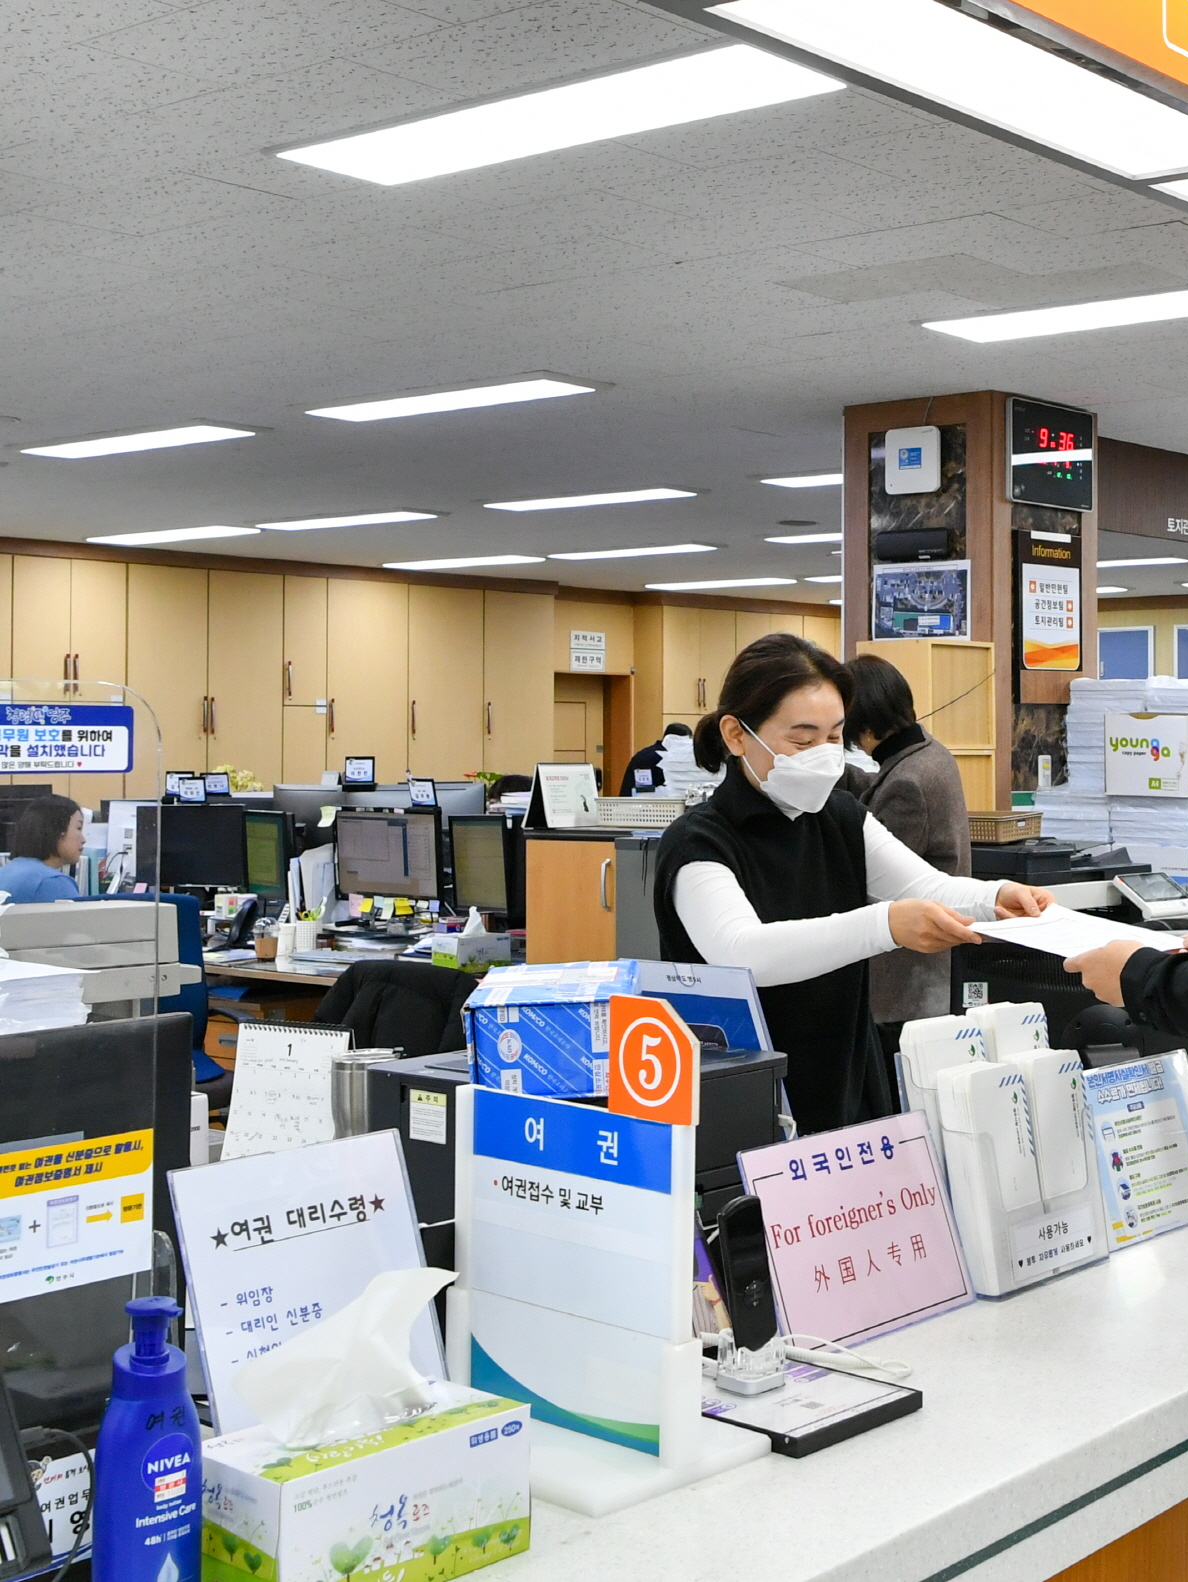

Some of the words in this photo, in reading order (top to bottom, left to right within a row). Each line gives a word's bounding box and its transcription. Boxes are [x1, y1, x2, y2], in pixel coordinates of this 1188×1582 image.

[1031, 544, 1071, 560] Information
[1039, 582, 1068, 595] 일반민원팀
[1034, 599, 1064, 611] 공간정보팀
[1034, 615, 1064, 628] 토지관리팀
[0, 728, 30, 742] 무원
[34, 728, 73, 742] 보호를
[77, 729, 113, 742] 위하여
[27, 744, 106, 758] 설치했습니다
[286, 1043, 293, 1057] 1
[1086, 1063, 1150, 1089] 본인서명사실확인서
[33, 1152, 63, 1169] 여권을
[65, 1144, 113, 1164] 신분증으로
[788, 1135, 895, 1182] 외국인전용
[14, 1167, 82, 1188] 여권정보증명서
[85, 1161, 104, 1173] 제시
[501, 1174, 555, 1206] 여권접수
[558, 1187, 572, 1211] 및
[575, 1192, 604, 1216] 교부
[230, 1215, 275, 1245] 여권
[286, 1194, 367, 1229] 대리수령
[769, 1223, 802, 1250] For
[807, 1190, 897, 1239] foreigner's
[900, 1182, 937, 1211] Only
[1038, 1220, 1069, 1241] 사용가능
[813, 1233, 928, 1294] 外国人专用
[236, 1286, 274, 1307] 위임장
[240, 1313, 279, 1333] 대리인
[286, 1302, 323, 1326] 신분증
[147, 1452, 191, 1475] NIVEA
[135, 1510, 179, 1529] Intensive
[179, 1502, 197, 1516] Care
[293, 1499, 313, 1513] 100%
[144, 1534, 162, 1546] 48h
